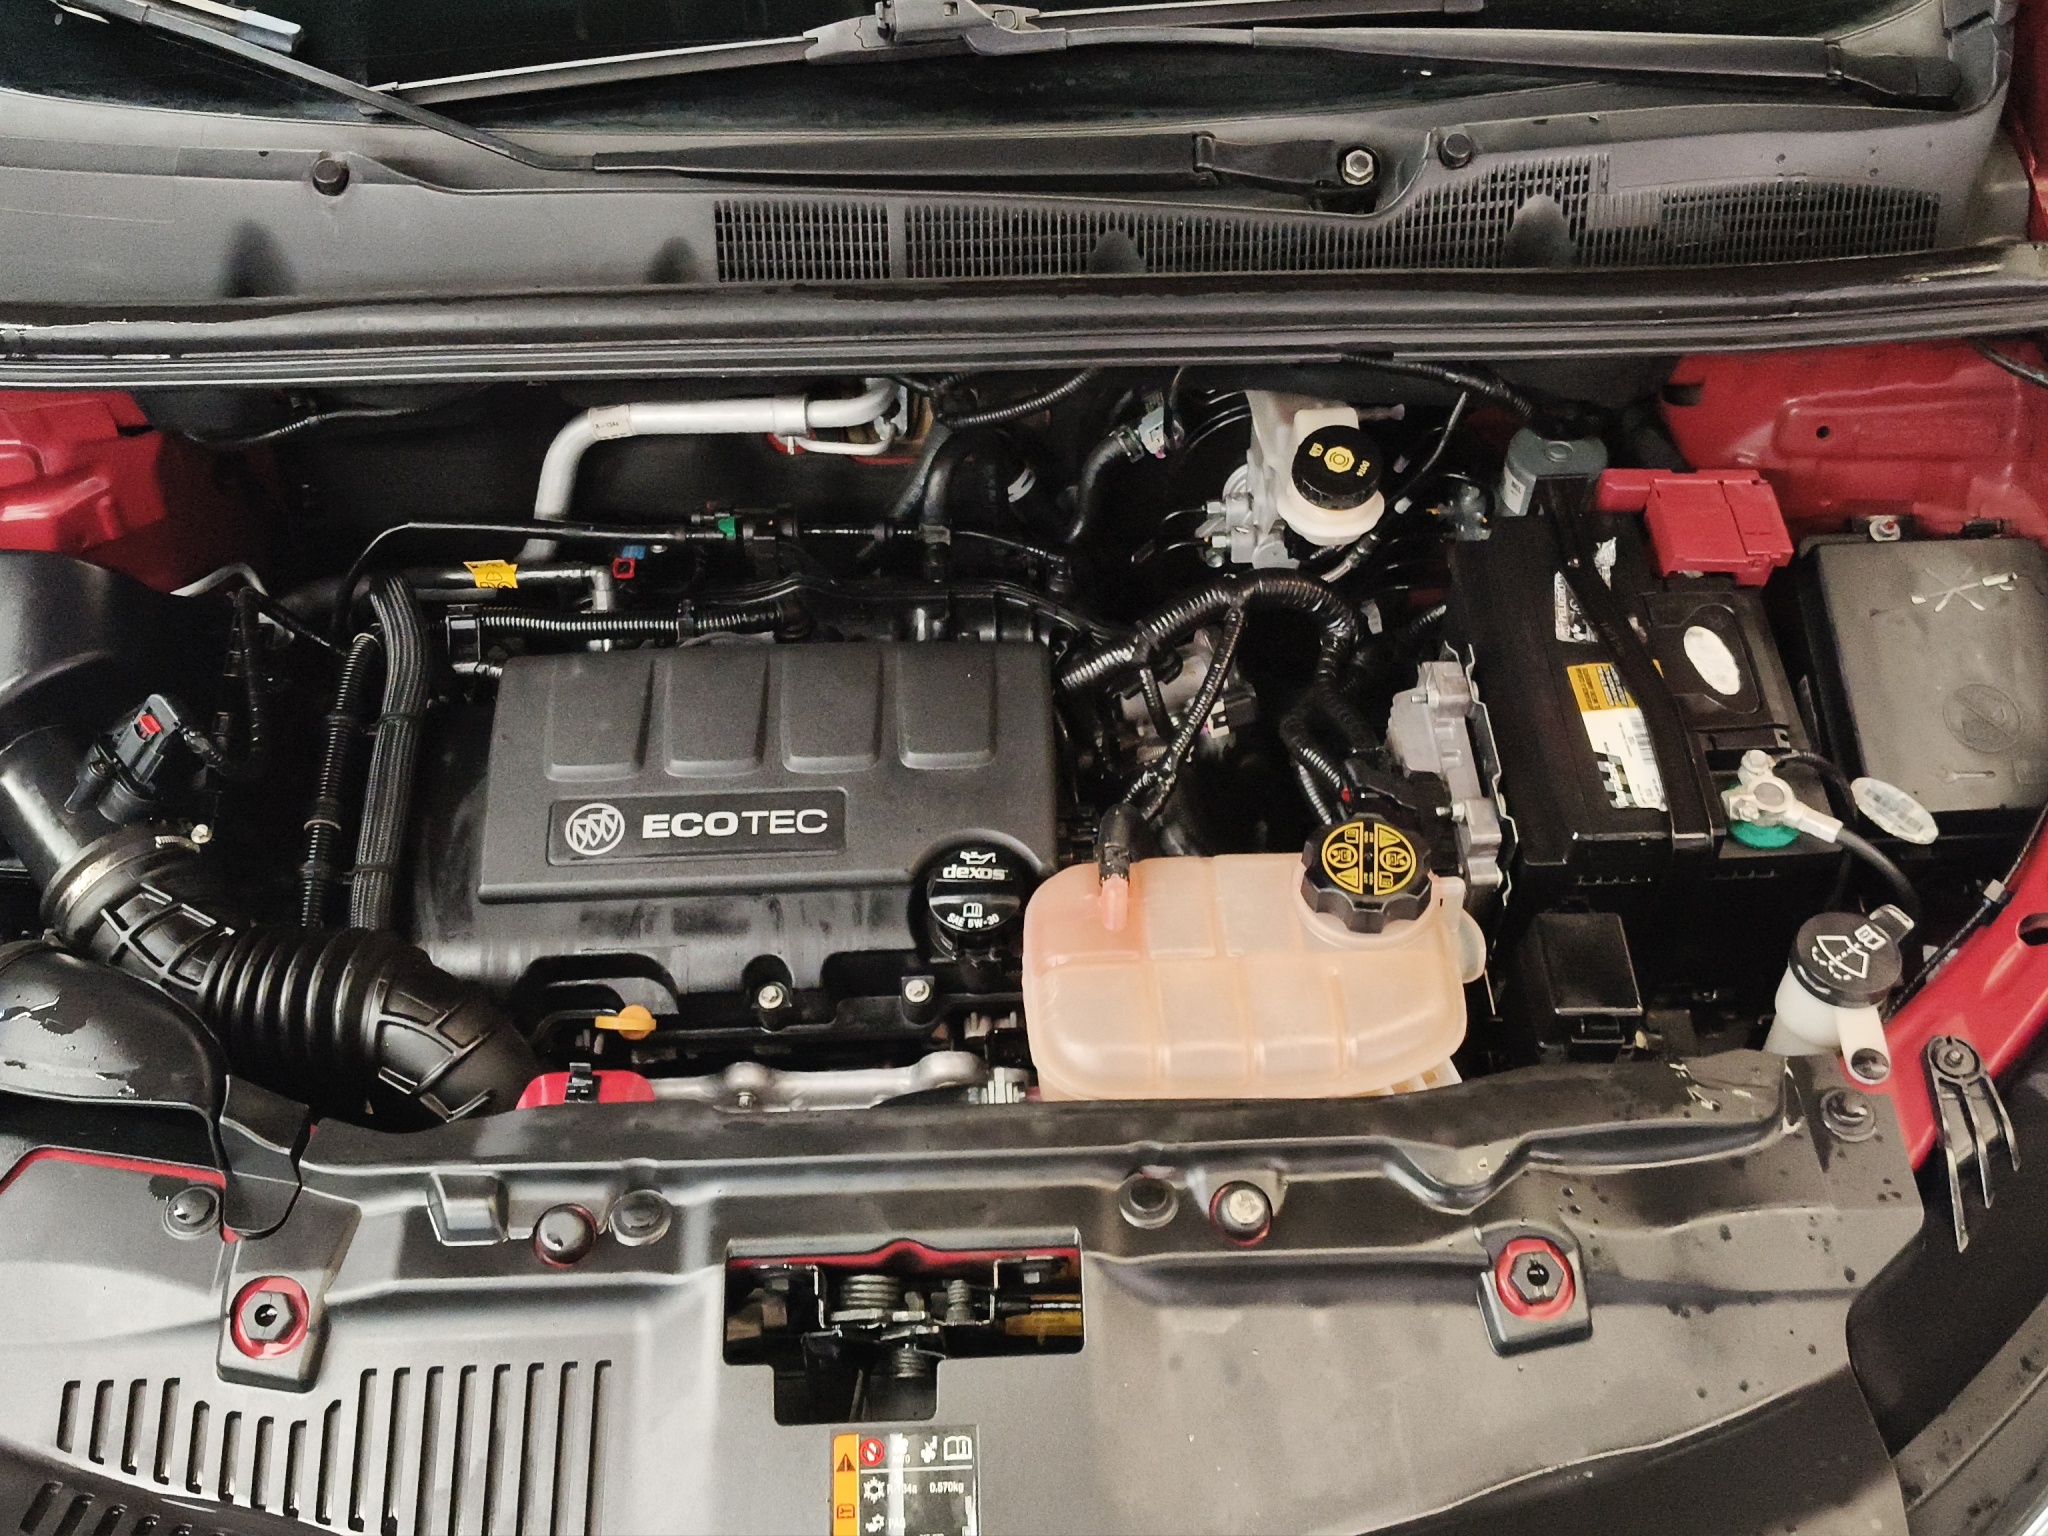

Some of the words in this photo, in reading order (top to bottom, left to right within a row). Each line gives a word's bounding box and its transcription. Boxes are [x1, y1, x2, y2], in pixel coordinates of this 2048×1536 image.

[642, 808, 828, 839] ECOTEC
[942, 863, 1005, 880] dexos
[947, 912, 965, 927] SAE
[967, 913, 1000, 929] 5W-30
